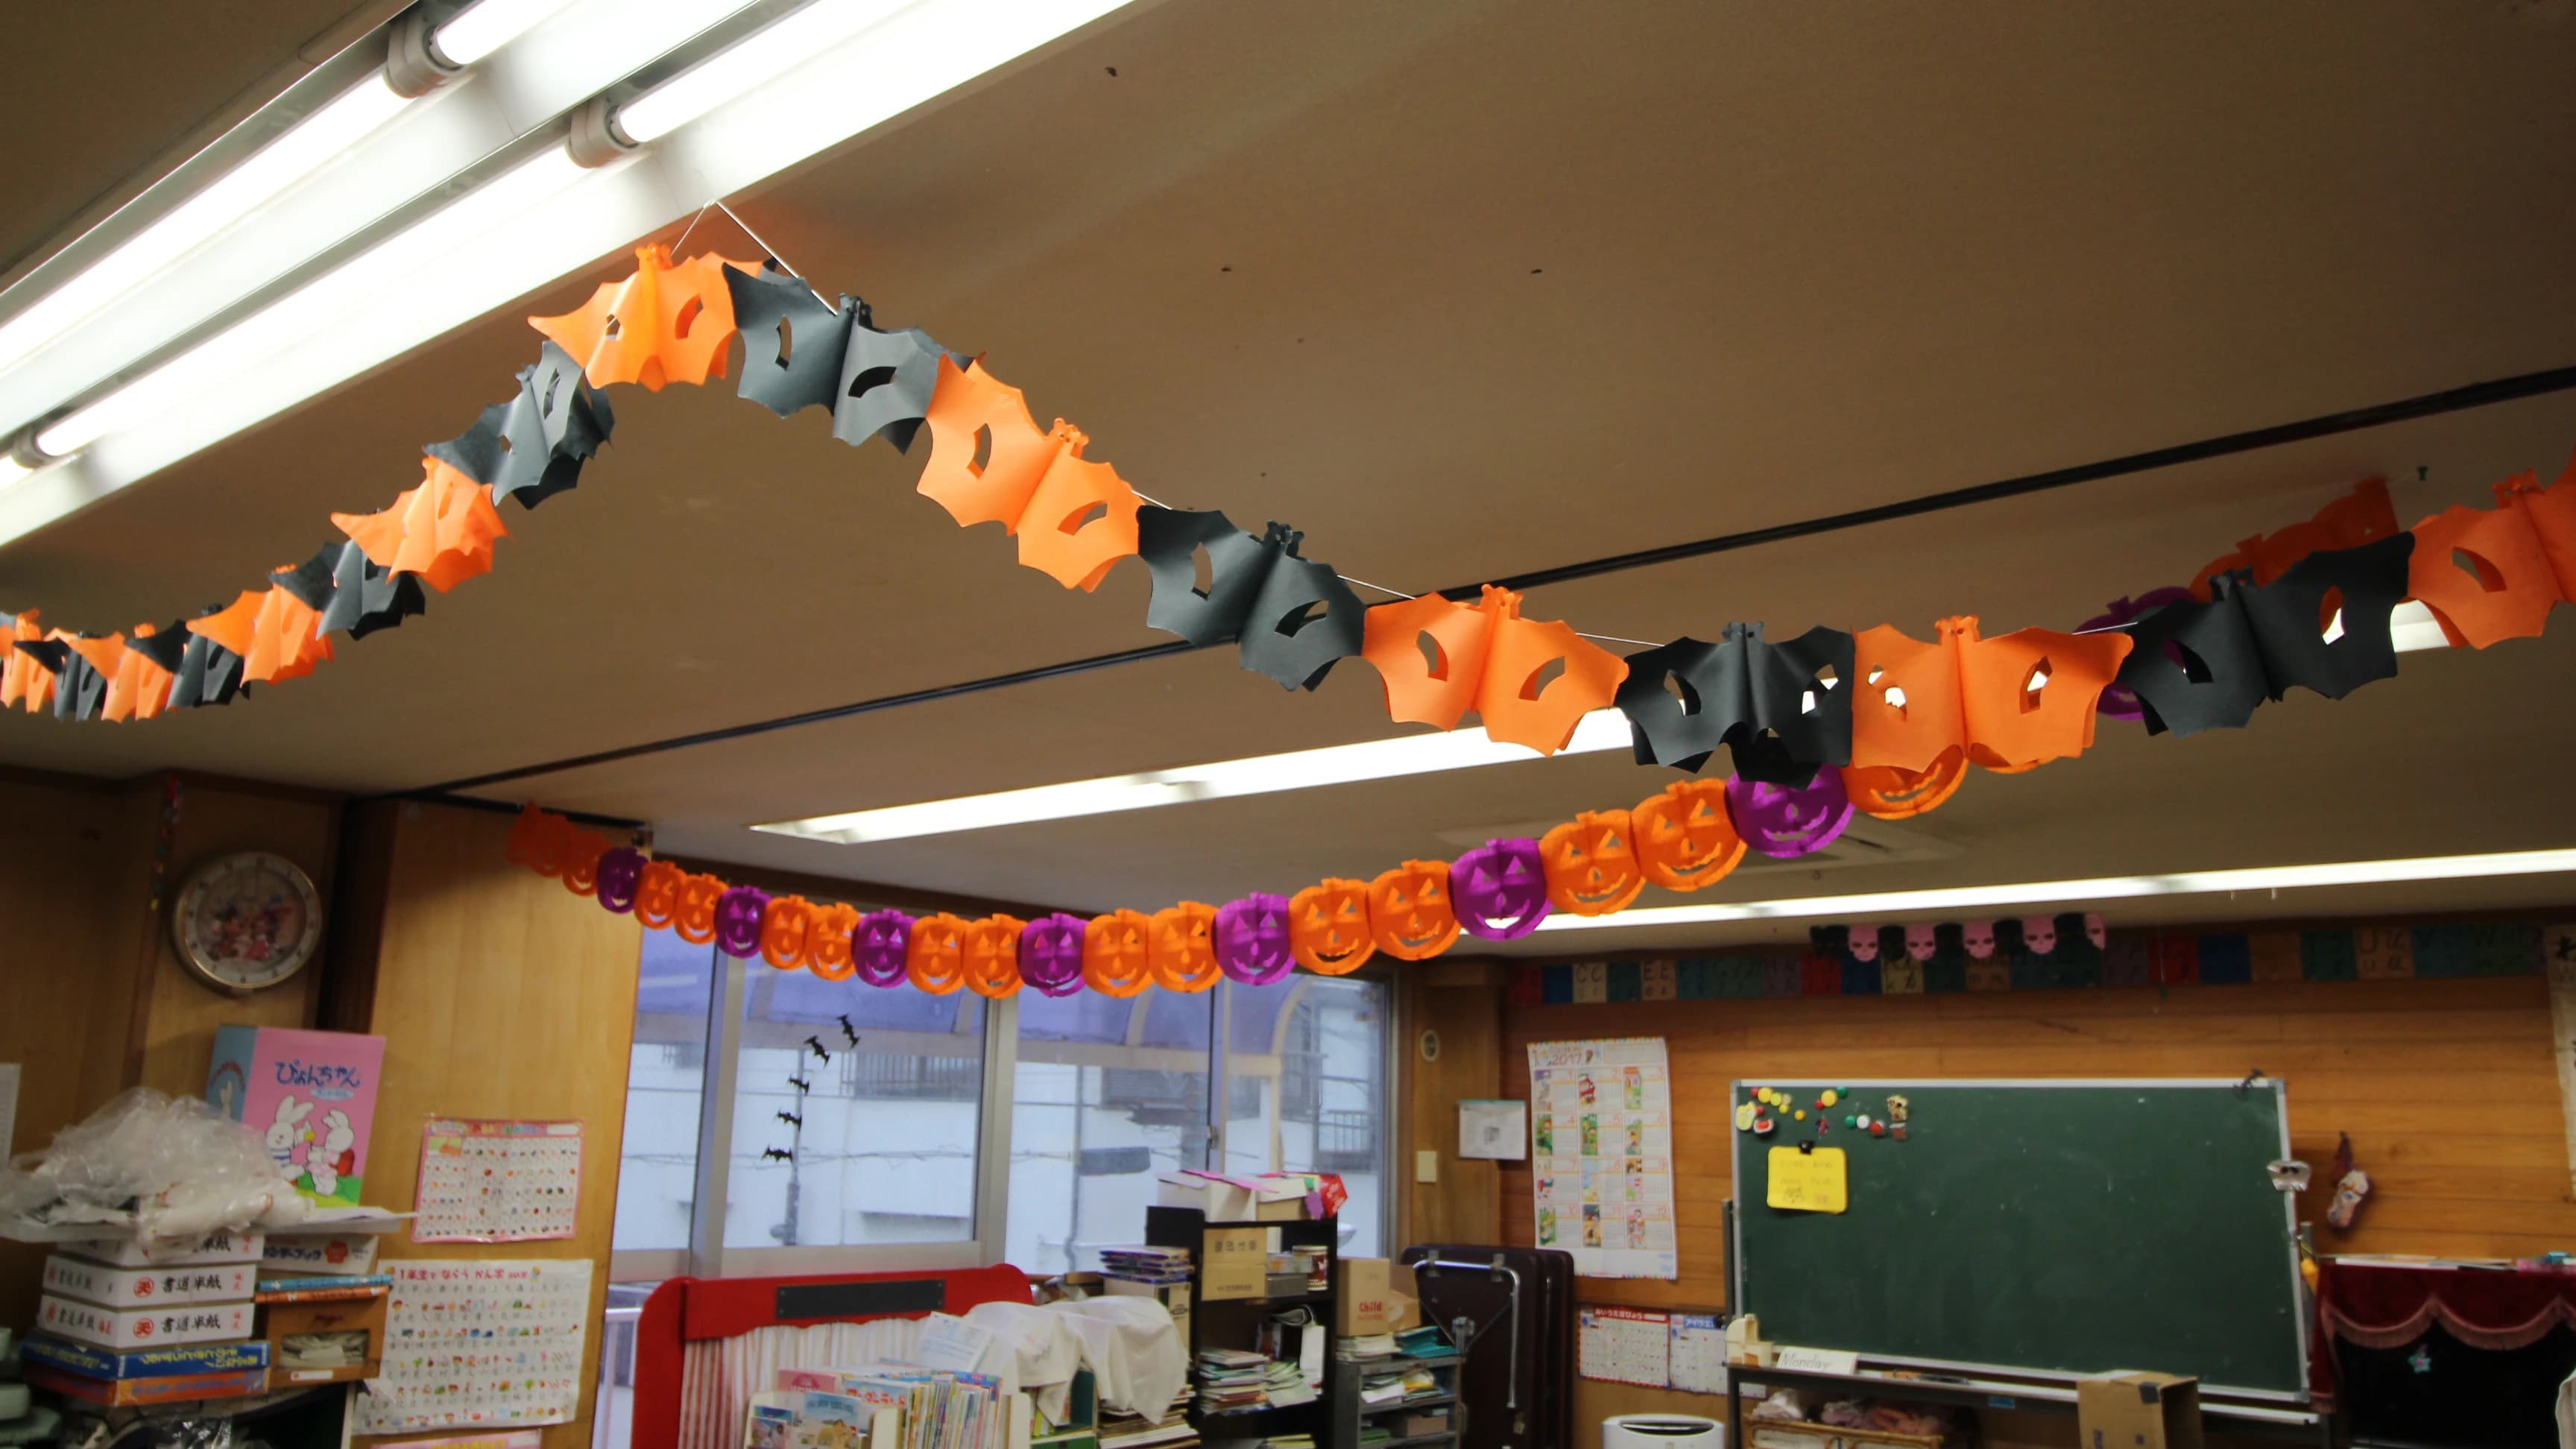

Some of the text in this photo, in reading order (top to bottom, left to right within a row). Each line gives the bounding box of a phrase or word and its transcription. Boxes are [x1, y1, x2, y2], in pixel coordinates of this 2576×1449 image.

[1552, 1053, 1582, 1065] 2017
[162, 1274, 221, 1293] 書道半紙
[162, 1314, 221, 1333] 書道半紙
[1685, 1318, 1716, 1329] アイウエ
[1781, 1353, 1831, 1370] Monday
